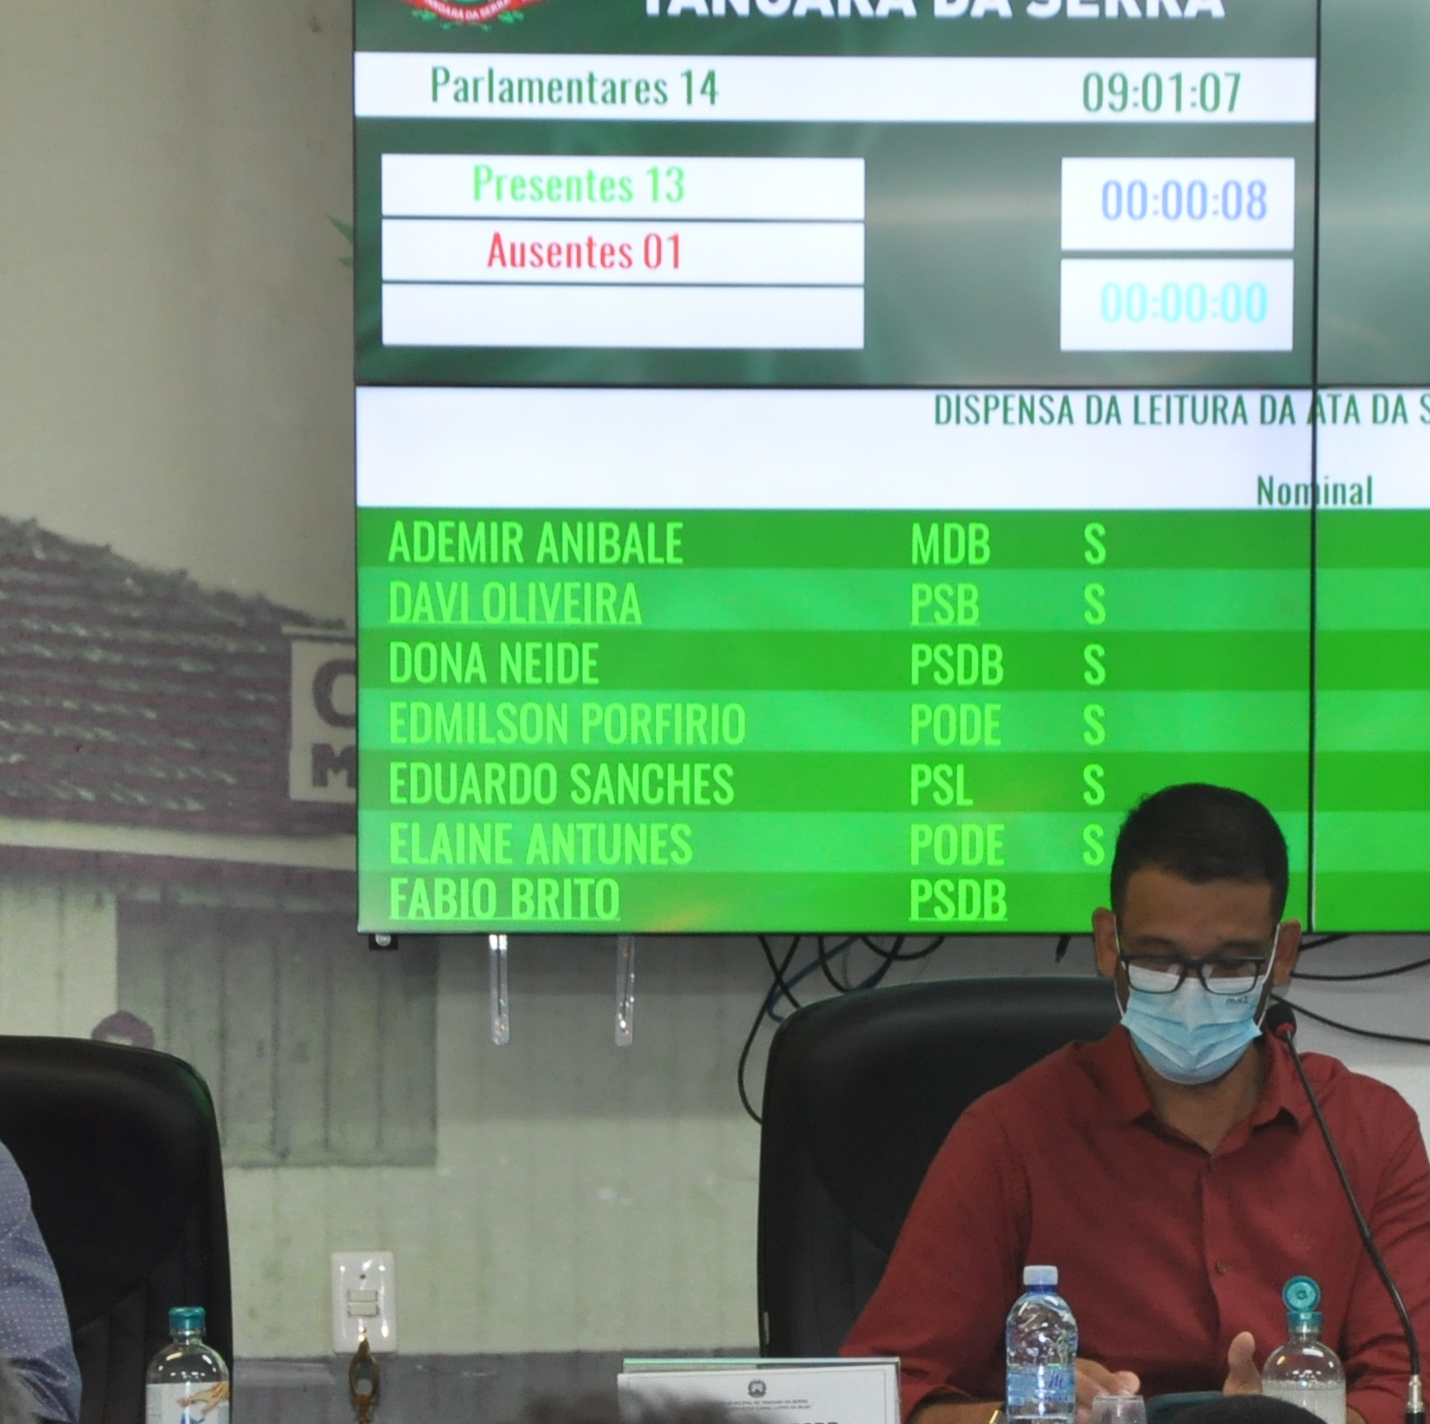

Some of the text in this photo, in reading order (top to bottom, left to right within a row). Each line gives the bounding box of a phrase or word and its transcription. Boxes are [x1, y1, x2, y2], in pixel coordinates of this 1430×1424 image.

[431, 66, 719, 105] Parlamentares 14
[1082, 71, 1241, 113] 09:01:07
[473, 164, 685, 203] Presentes 13
[1101, 179, 1267, 221] 00:00:08
[487, 231, 680, 269] Ausentes 01
[1100, 281, 1268, 323] 00:00:00
[933, 393, 1074, 425] DISPENSA
[1085, 393, 1122, 425] DA
[1133, 393, 1248, 425] LEITURA
[1259, 393, 1296, 425] DA
[1306, 393, 1360, 425] ATA
[1372, 393, 1408, 424] DA
[1257, 475, 1373, 506] Nominal
[388, 521, 684, 564] ADEMIR ANIBALE
[911, 522, 991, 565] MDB
[1083, 522, 1106, 565] S
[389, 581, 642, 625] DAVI OLIVEIRA
[910, 582, 979, 626] PSB
[1083, 582, 1106, 625] S
[389, 641, 599, 684] DONA NEIDE
[911, 643, 1004, 686] PSDB
[1083, 643, 1106, 686] S
[389, 701, 746, 745] EDMILSON PORFIRIO
[910, 703, 1001, 746] PODE
[1083, 703, 1105, 746] S
[390, 762, 735, 805] EDUARDO SANCHES
[910, 764, 973, 806] PSL
[1082, 764, 1105, 806] S
[390, 822, 693, 865] ELAINE ANTUNES
[910, 824, 1005, 866] PODE
[1082, 824, 1105, 866] S
[389, 878, 620, 920] FABIO BRITO
[909, 879, 1007, 922] PSDB
